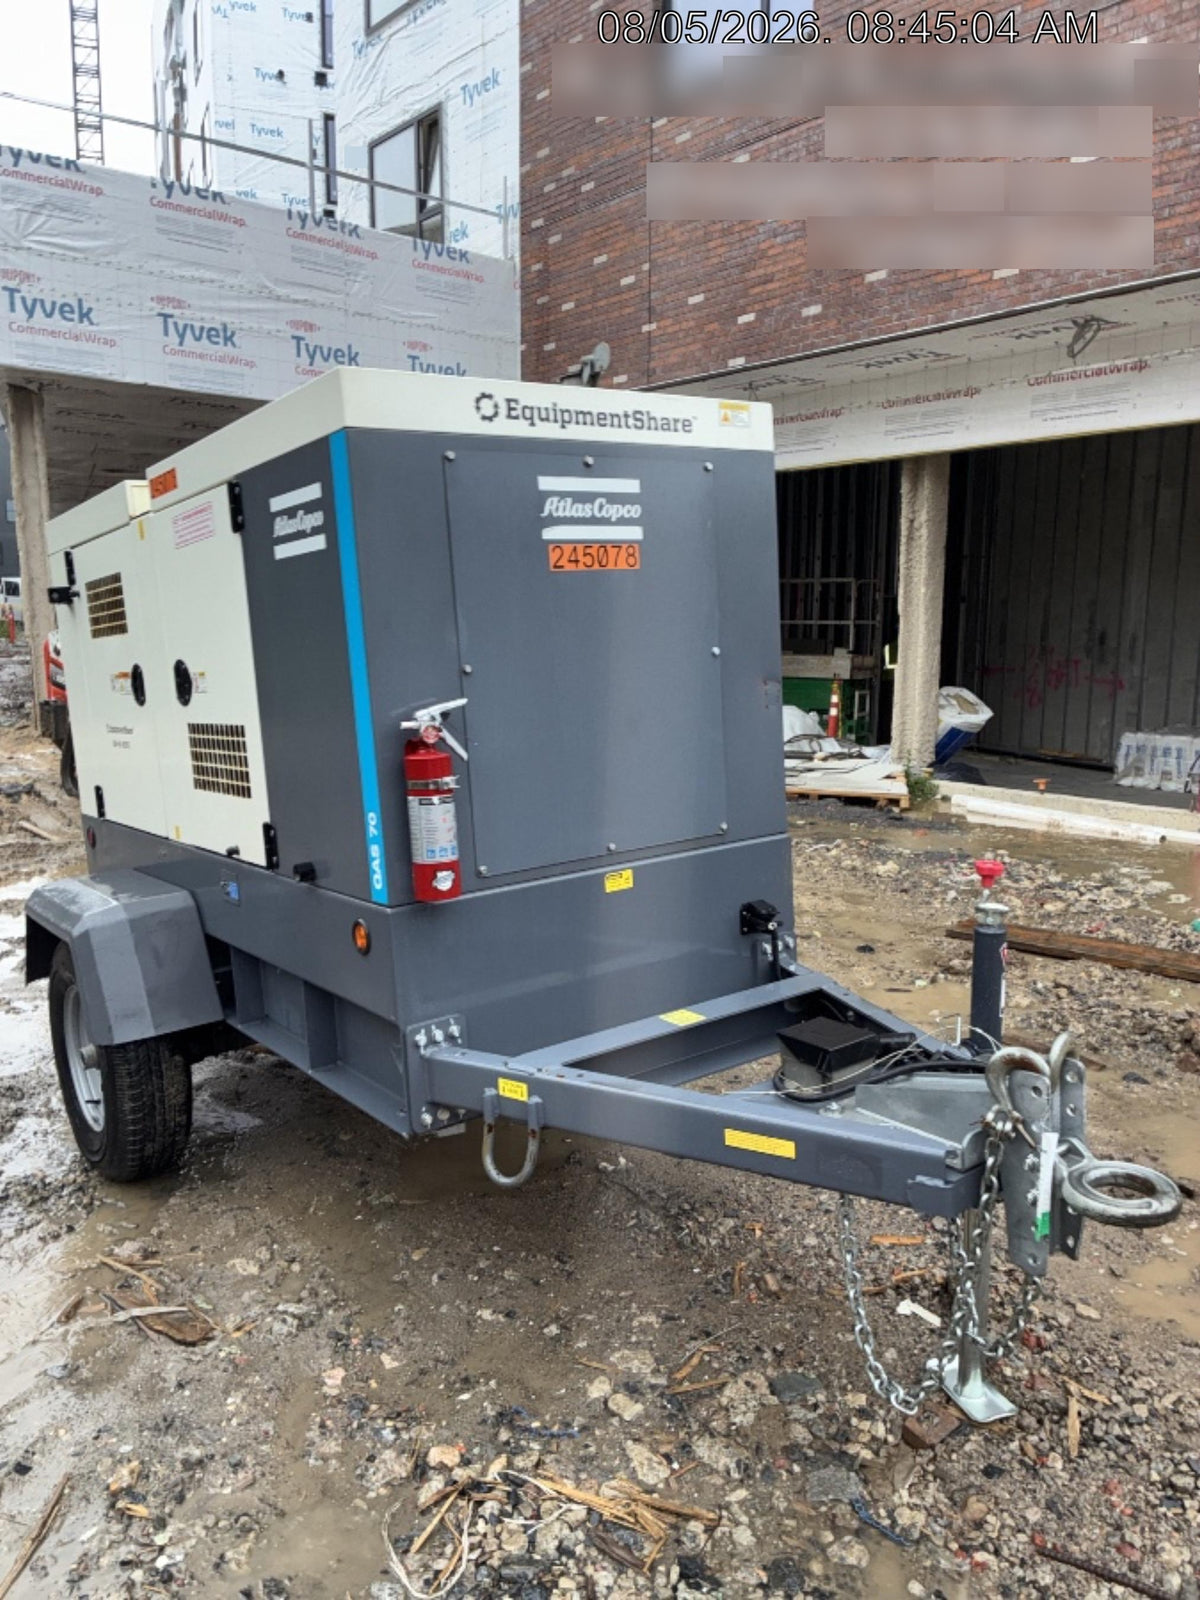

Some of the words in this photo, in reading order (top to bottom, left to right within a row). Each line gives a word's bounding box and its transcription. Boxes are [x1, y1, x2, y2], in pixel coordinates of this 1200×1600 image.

[460, 67, 501, 107] Tyvek
[249, 122, 284, 138] Tyvek
[0, 145, 82, 173] yvek
[0, 168, 104, 197] ommercialWrap
[1, 285, 95, 326] Tyvek
[8, 320, 117, 348] CommercialWrap
[155, 312, 237, 348] Tyvek
[162, 343, 257, 369] CommercialWrap
[290, 334, 360, 367] Tyvek
[504, 398, 693, 434] EquipmentShare
[551, 544, 638, 569] 245078
[367, 812, 378, 838] 70
[370, 844, 383, 890] QAS
